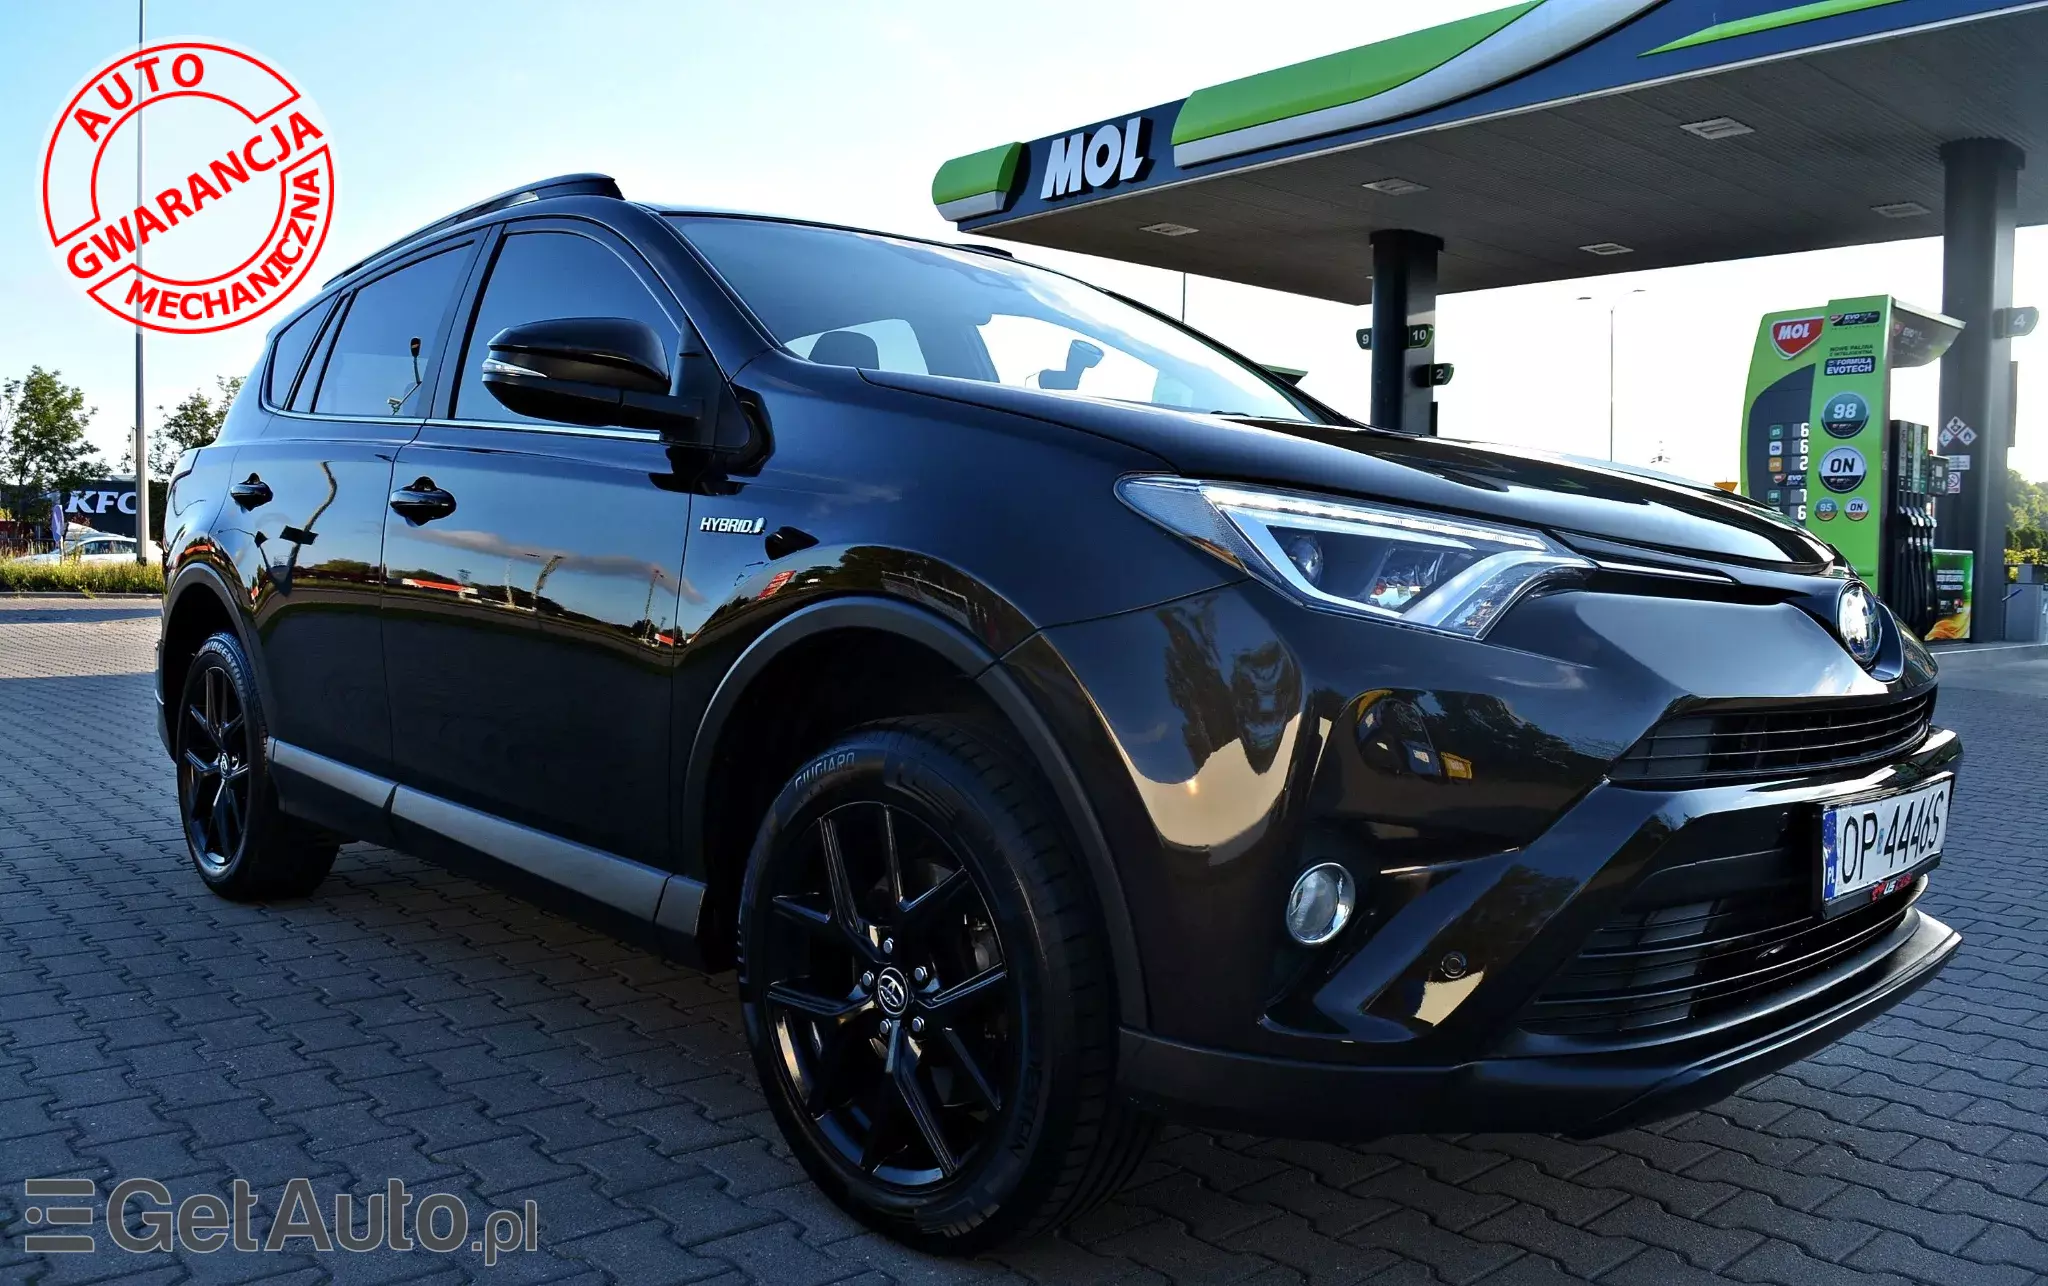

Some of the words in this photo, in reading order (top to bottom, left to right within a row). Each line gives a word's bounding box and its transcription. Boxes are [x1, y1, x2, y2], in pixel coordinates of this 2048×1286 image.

[1040, 116, 1145, 200] MOL
[2013, 313, 2027, 328] 4
[1361, 333, 1370, 345] 9
[1412, 329, 1427, 341] 10
[1777, 322, 1811, 341] MOL
[1836, 357, 1872, 366] FORMULA
[1435, 368, 1445, 379] 2
[1826, 364, 1872, 375] EVOTECH
[1833, 403, 1858, 420] 98
[1830, 458, 1856, 474] ON
[1819, 503, 1833, 512] 95
[1850, 503, 1864, 511] ON
[700, 516, 753, 533] HYBRID
[1841, 810, 1878, 884] OP
[1827, 866, 1836, 886] PL
